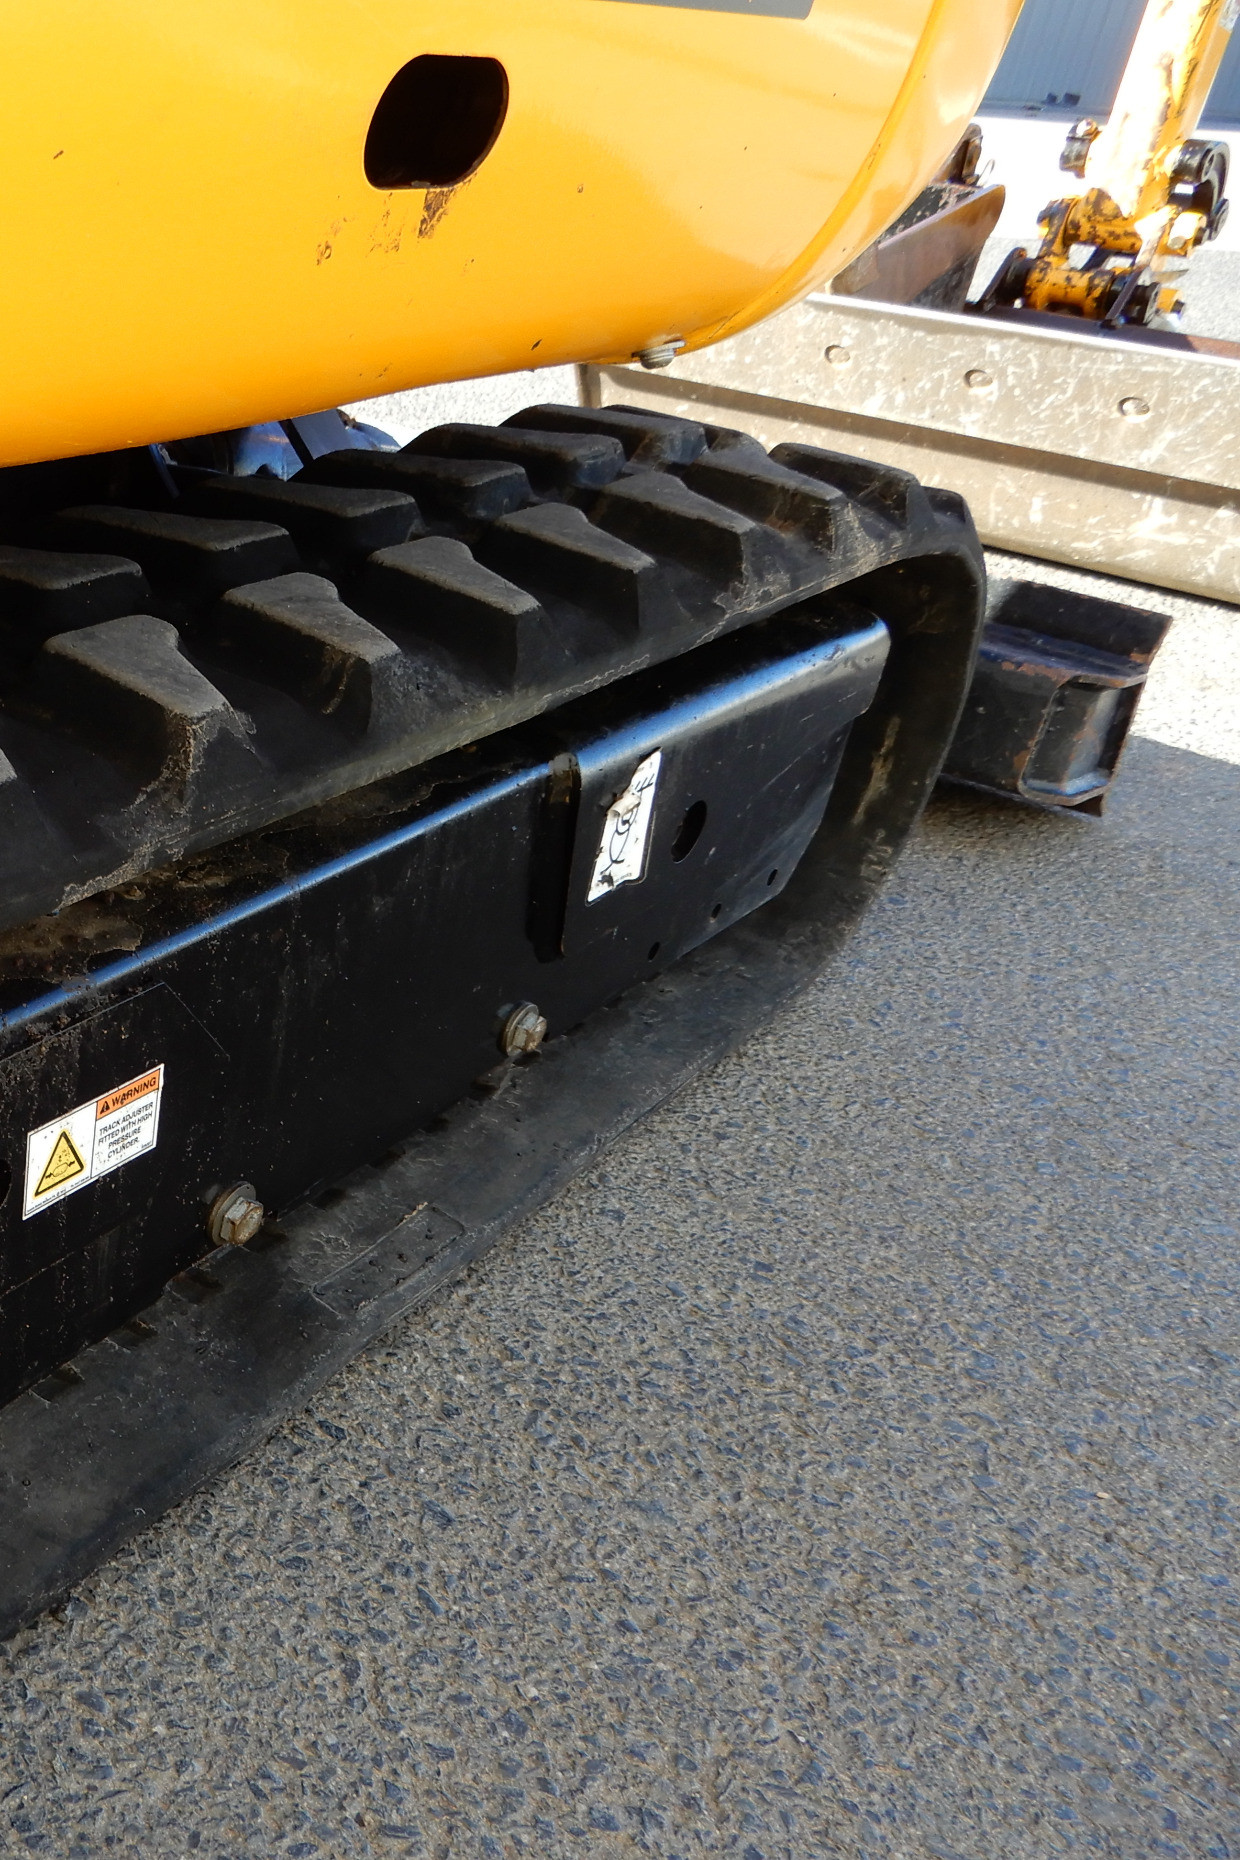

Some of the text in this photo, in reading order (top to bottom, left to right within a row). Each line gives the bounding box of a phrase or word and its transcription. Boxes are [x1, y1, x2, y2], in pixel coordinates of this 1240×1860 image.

[111, 1077, 157, 1106] WARNING
[98, 1111, 153, 1146] FITTED WITH HIGH
[99, 1102, 154, 1136] TRACK ADJUSTER
[107, 1137, 139, 1158] CYLINDER.
[108, 1126, 142, 1149] PRESSURE
